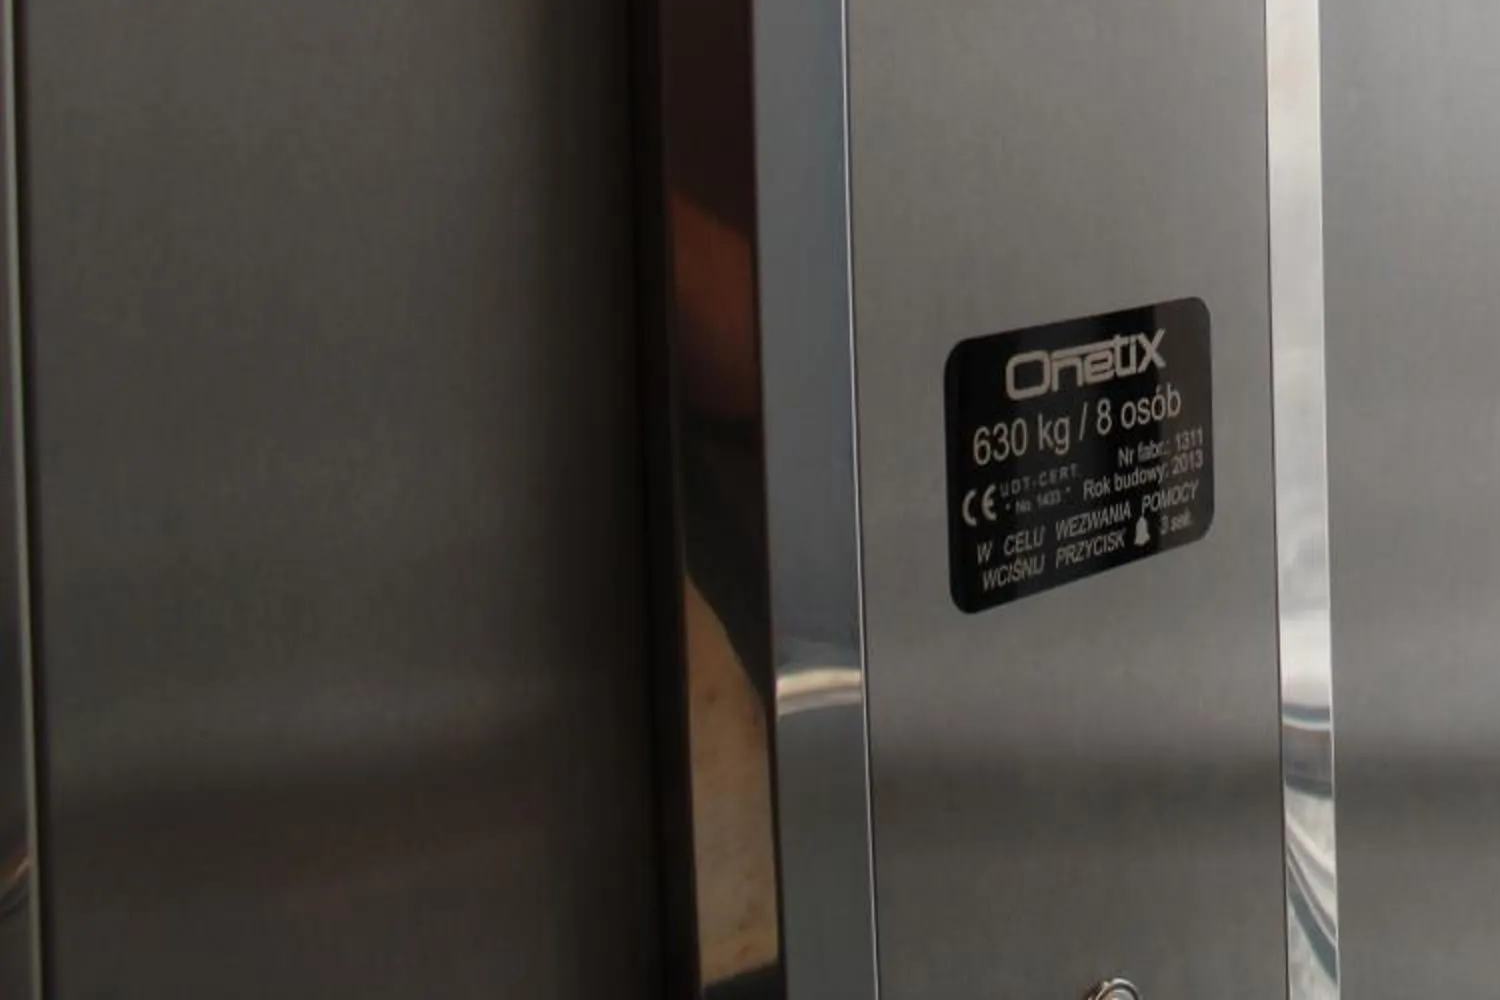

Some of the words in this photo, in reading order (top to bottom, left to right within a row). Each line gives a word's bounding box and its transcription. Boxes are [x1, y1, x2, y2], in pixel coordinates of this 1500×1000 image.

[973, 418, 1028, 466] 630
[1038, 413, 1070, 455] kg
[1079, 401, 1088, 441] /
[1097, 397, 1112, 436] 8
[1120, 382, 1182, 430] osób
[1083, 477, 1111, 501] Rok
[1171, 449, 1204, 475] 2013
[1117, 446, 1135, 468] Nr
[976, 541, 993, 565] W
[1003, 525, 1046, 556] CELU
[1055, 500, 1132, 541] WEZWANIA
[1141, 479, 1200, 514] POMOCY
[1055, 528, 1127, 570] PRZYCISK
